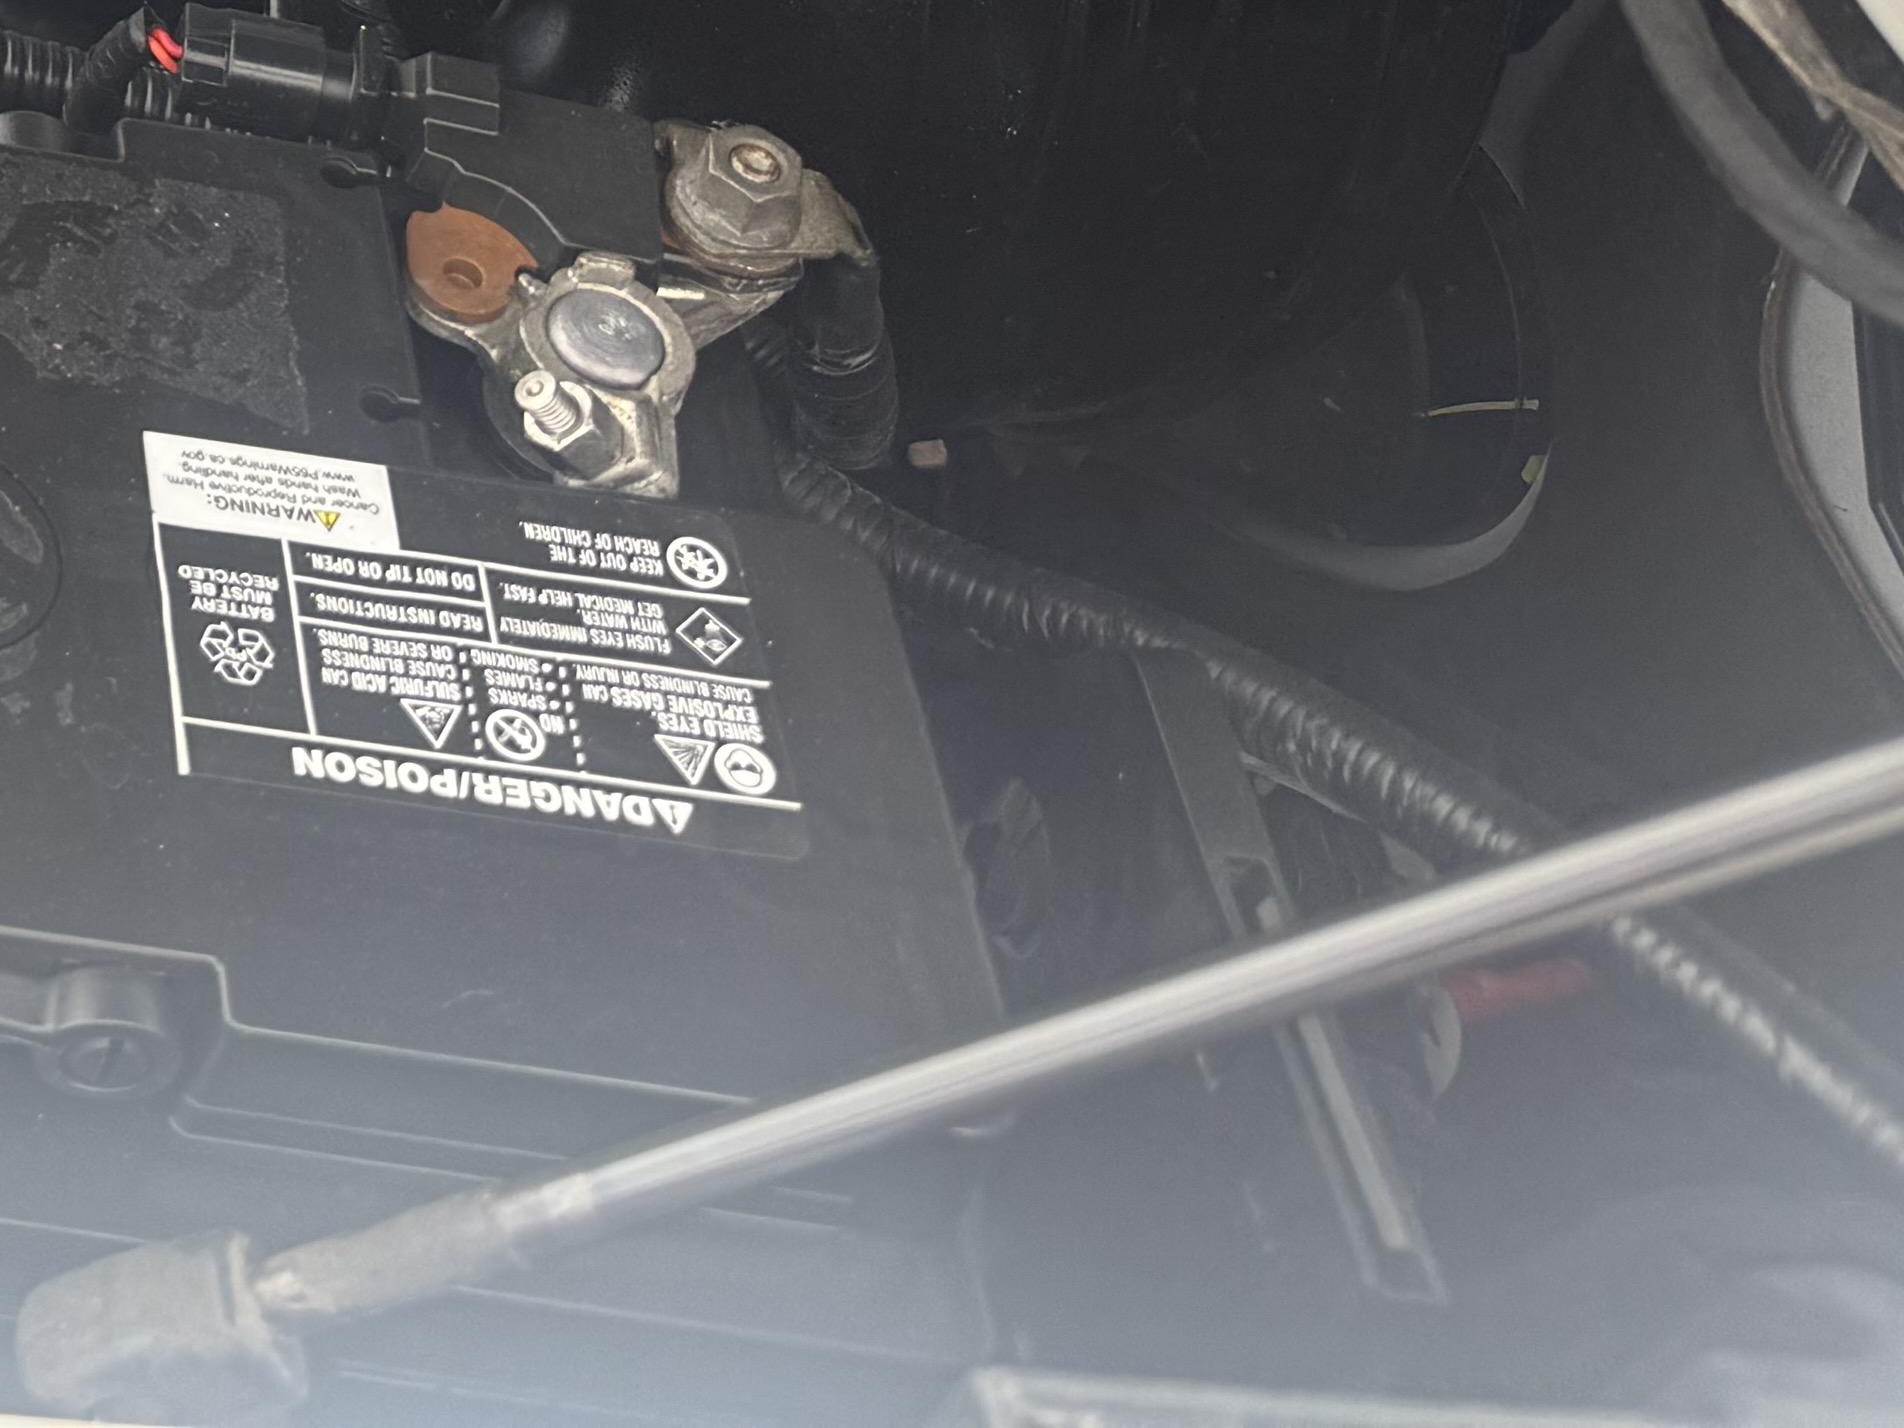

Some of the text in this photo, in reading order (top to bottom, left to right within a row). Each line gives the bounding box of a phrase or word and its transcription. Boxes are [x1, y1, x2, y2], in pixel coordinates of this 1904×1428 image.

[177, 460, 363, 500] Wash hands after handling.
[180, 449, 356, 485] www.P65Warnings.ca.gov
[162, 473, 380, 516] Cancer and Reproductive Harm.
[205, 494, 318, 526] WARNING:
[517, 520, 661, 559] REACH OF CHILDREN.
[177, 563, 280, 592] RECYCLED
[304, 550, 476, 593] DO NOT TIP OR OPEN.
[547, 543, 665, 578] KEEP OUT OF THE
[187, 578, 273, 607] MUST BE
[190, 595, 276, 623] BATTERY
[497, 582, 664, 621] GET MEDICAL HELP FAST.
[308, 592, 484, 633] READ INSTRUCTIONS.
[576, 608, 668, 637] WITH WATER.
[311, 627, 454, 662] OR SEVERE BURNS.
[499, 615, 672, 655] FLUSH EYES IMMEDIATELY
[320, 647, 458, 682] CAUSE BLINDNESS
[470, 648, 540, 675] SMOKING
[320, 666, 462, 702] SULFURIC ACID CAN
[484, 668, 544, 692] FLAMES
[571, 663, 753, 703] CAUSE BLINDNESS OR INJURY.
[487, 686, 548, 710] SPARKS
[582, 682, 759, 725] EXPLOSIVE GASES CAN
[538, 712, 565, 736] NO
[650, 710, 765, 744] SHIELD EYES.
[291, 747, 655, 827] DANGER/POISON
